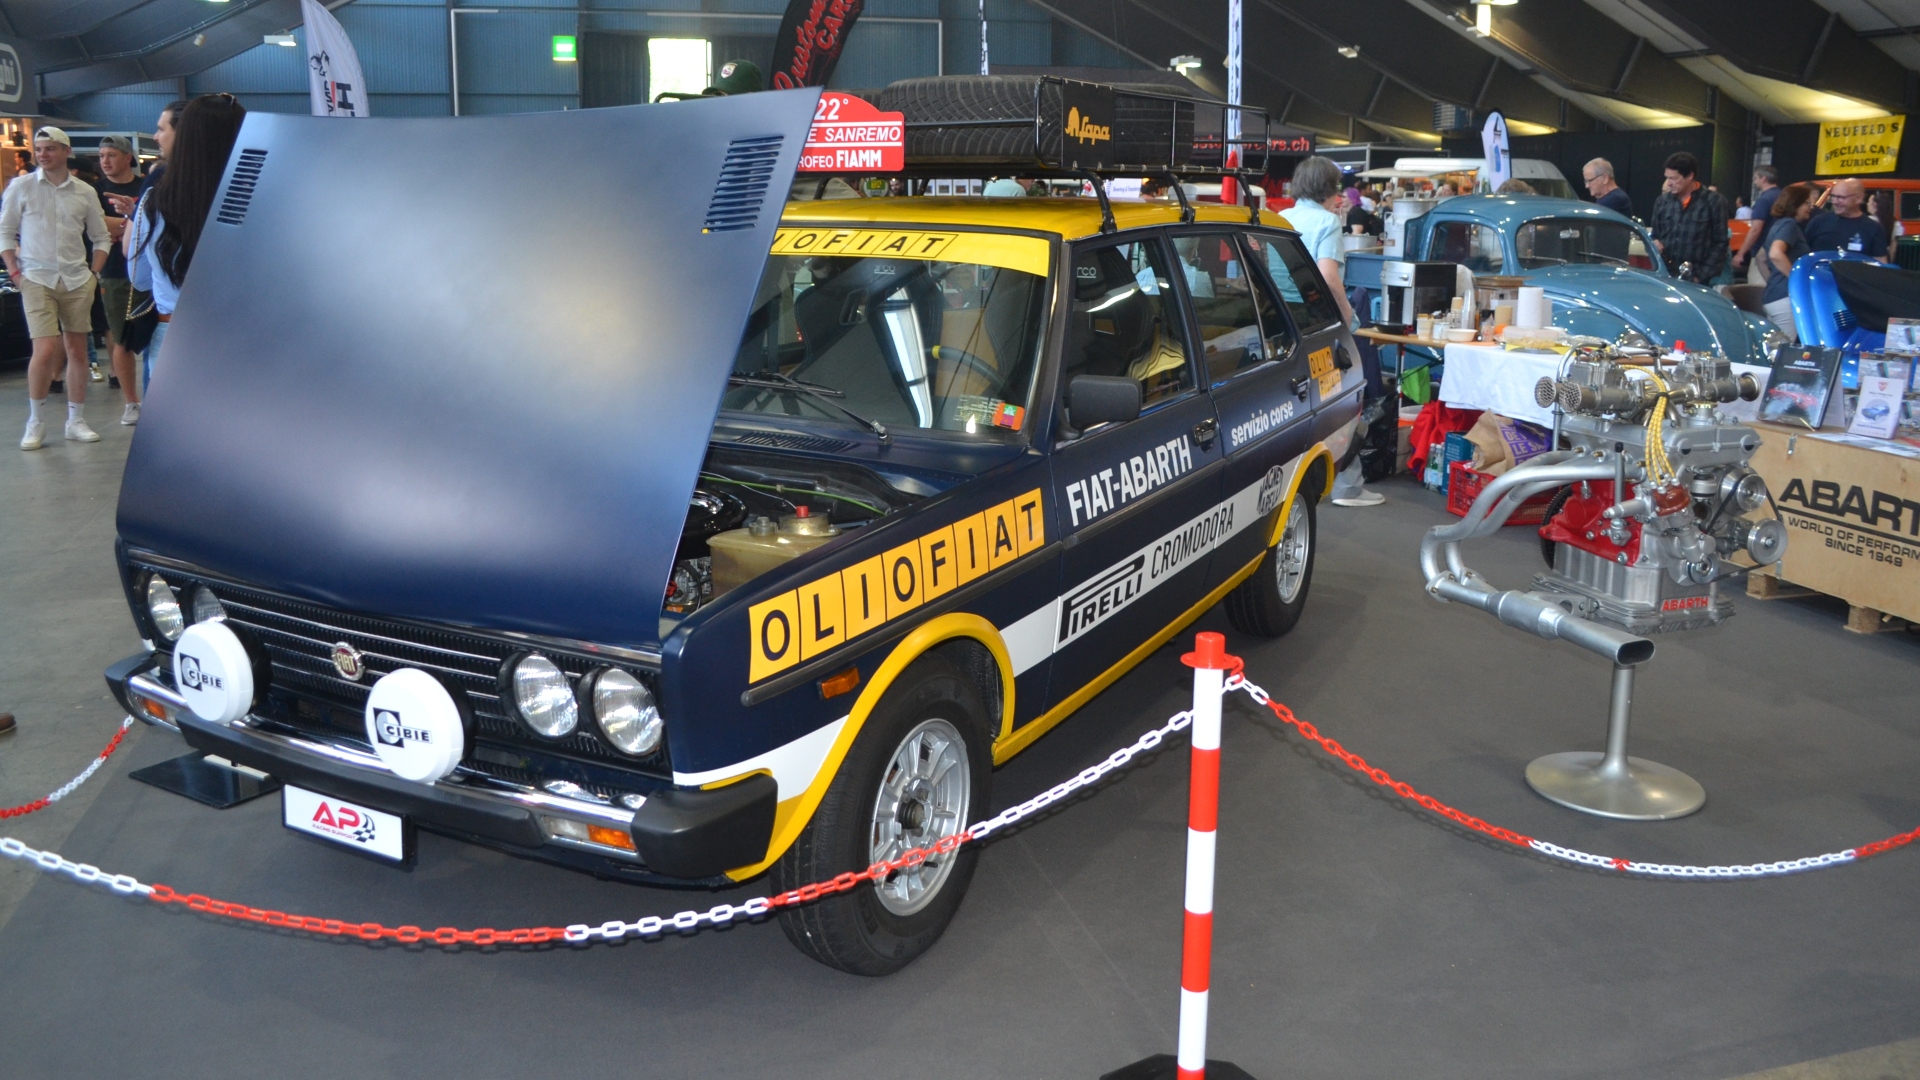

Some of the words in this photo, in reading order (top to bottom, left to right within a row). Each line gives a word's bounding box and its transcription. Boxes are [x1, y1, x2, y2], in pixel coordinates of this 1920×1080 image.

[825, 127, 901, 142] SANREMO
[836, 149, 882, 168] FIAMM
[1825, 145, 1866, 162] SPECIAL
[1231, 409, 1269, 446] servizio
[1270, 400, 1294, 427] corse
[1512, 442, 1529, 456] LE
[1066, 434, 1193, 527] FIAT-ABARTH
[1788, 516, 1833, 536] WORLD
[1836, 529, 1854, 541] OF
[1824, 537, 1864, 557] SINCE
[1868, 549, 1903, 567] 1949
[1059, 554, 1145, 643] PIRELLI
[1151, 503, 1234, 579] CROMODORA
[1661, 596, 1710, 612] ABARTH
[336, 652, 356, 672] FIAT
[312, 801, 361, 830] AP
